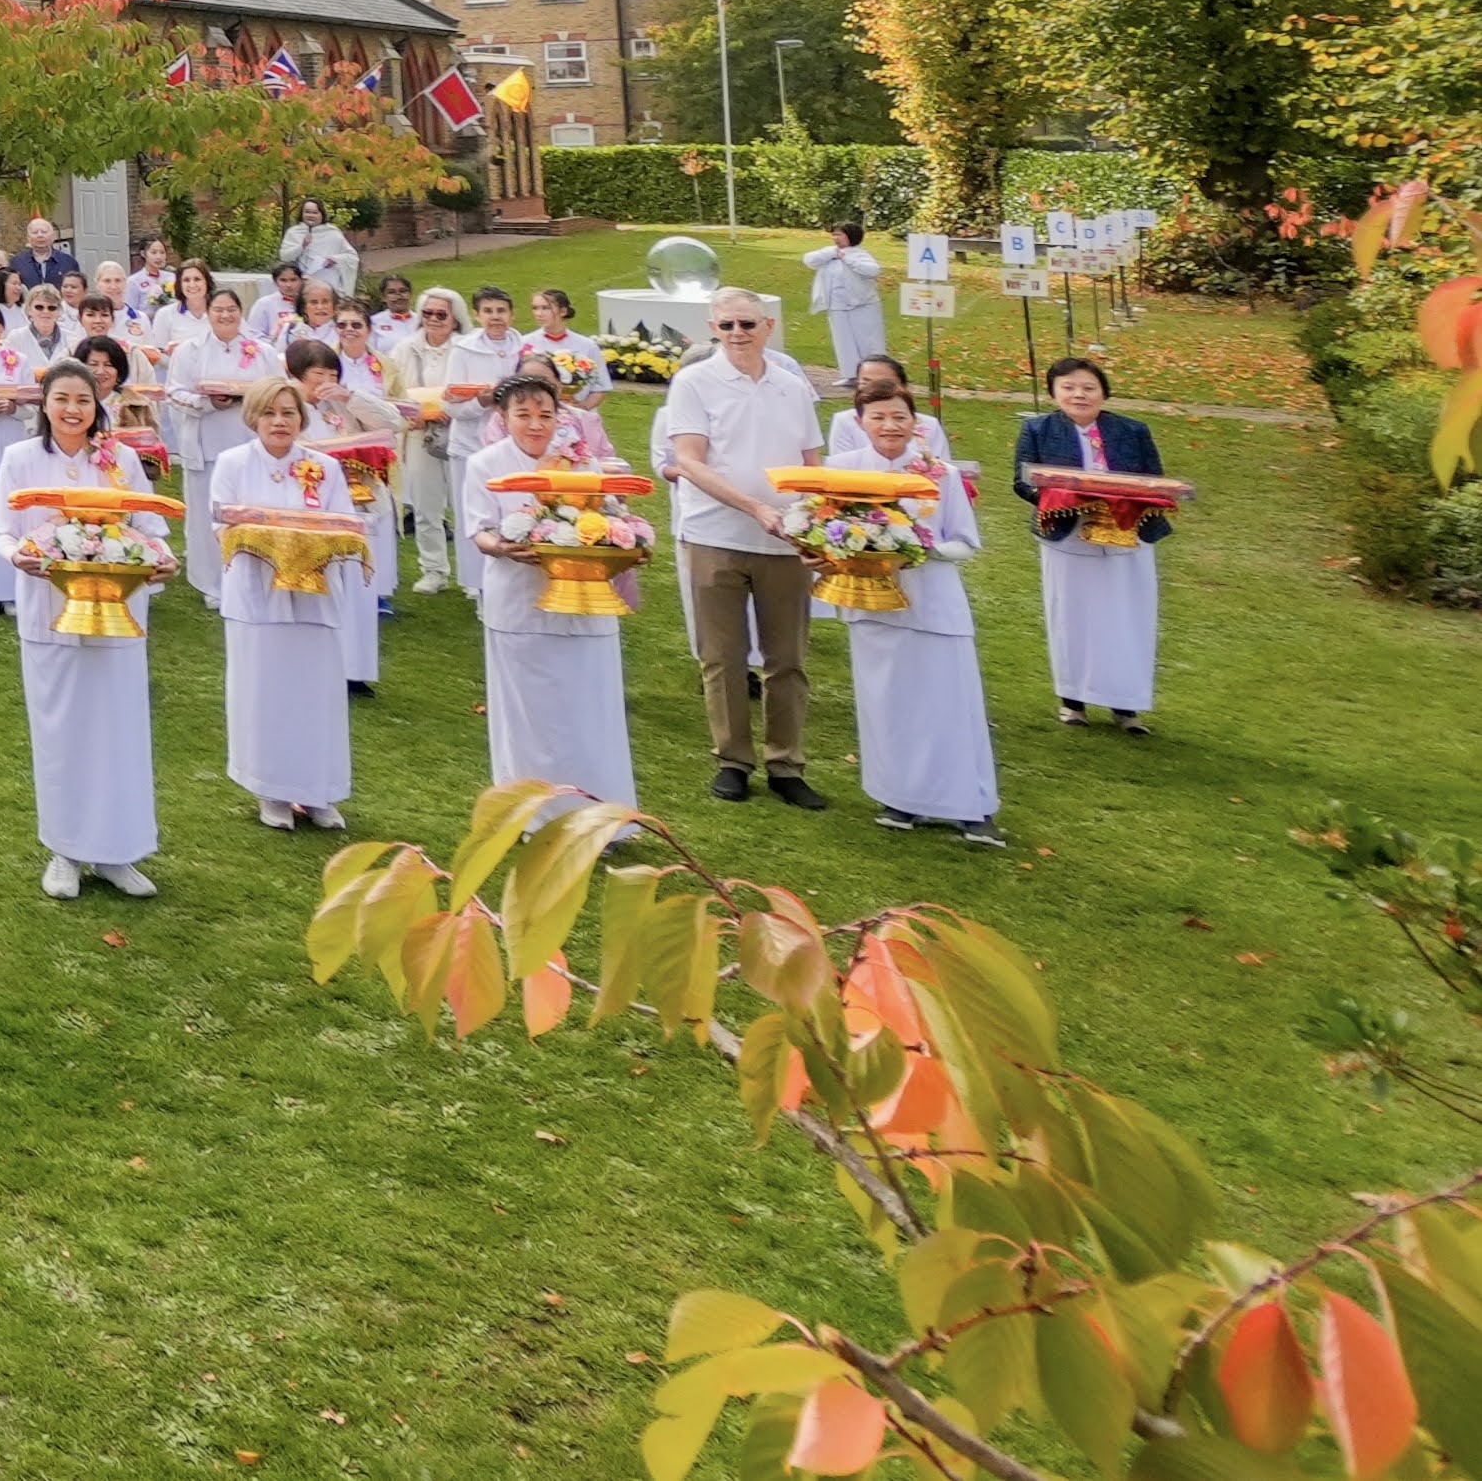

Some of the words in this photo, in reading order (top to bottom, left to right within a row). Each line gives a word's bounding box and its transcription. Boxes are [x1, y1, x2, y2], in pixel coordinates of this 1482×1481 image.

[1055, 221, 1066, 234] C
[1084, 228, 1096, 239] D
[1011, 237, 1024, 251] B
[919, 246, 936, 264] A
